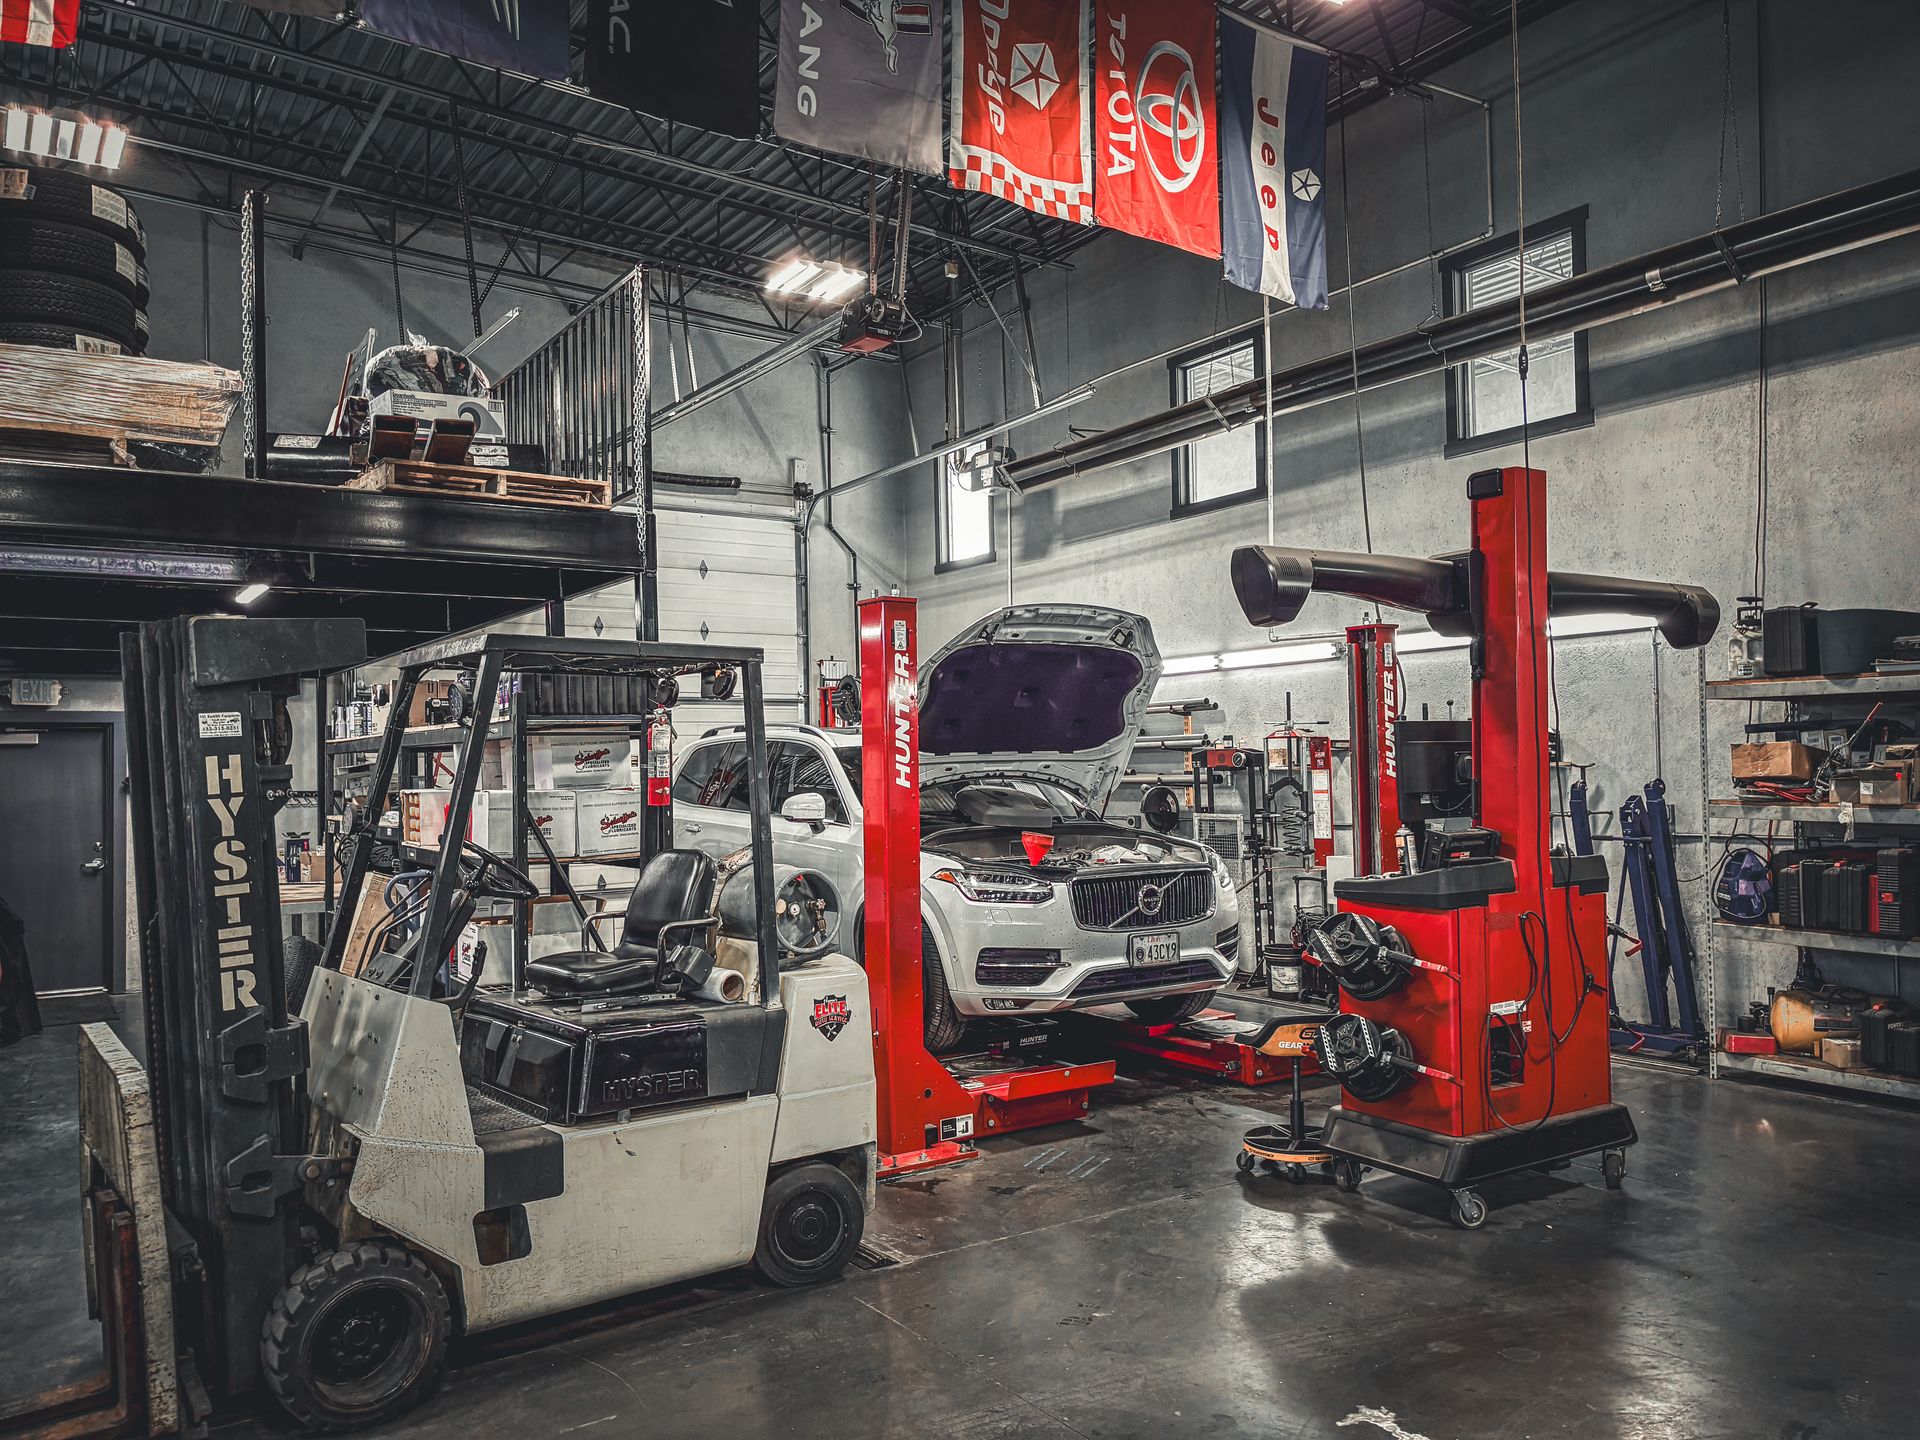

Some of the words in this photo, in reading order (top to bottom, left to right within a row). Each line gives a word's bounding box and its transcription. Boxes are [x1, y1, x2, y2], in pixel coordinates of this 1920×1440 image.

[1257, 96, 1280, 251] Jeep
[20, 680, 52, 702] EXIT
[894, 652, 912, 789] HUNTER
[1383, 670, 1397, 778] HUNTER
[205, 754, 259, 1012] HYSTER
[1147, 942, 1178, 961] 43CY9
[815, 1001, 847, 1019] ELITE
[1278, 1041, 1309, 1050] GEAR
[603, 1068, 703, 1101] HYSTER
